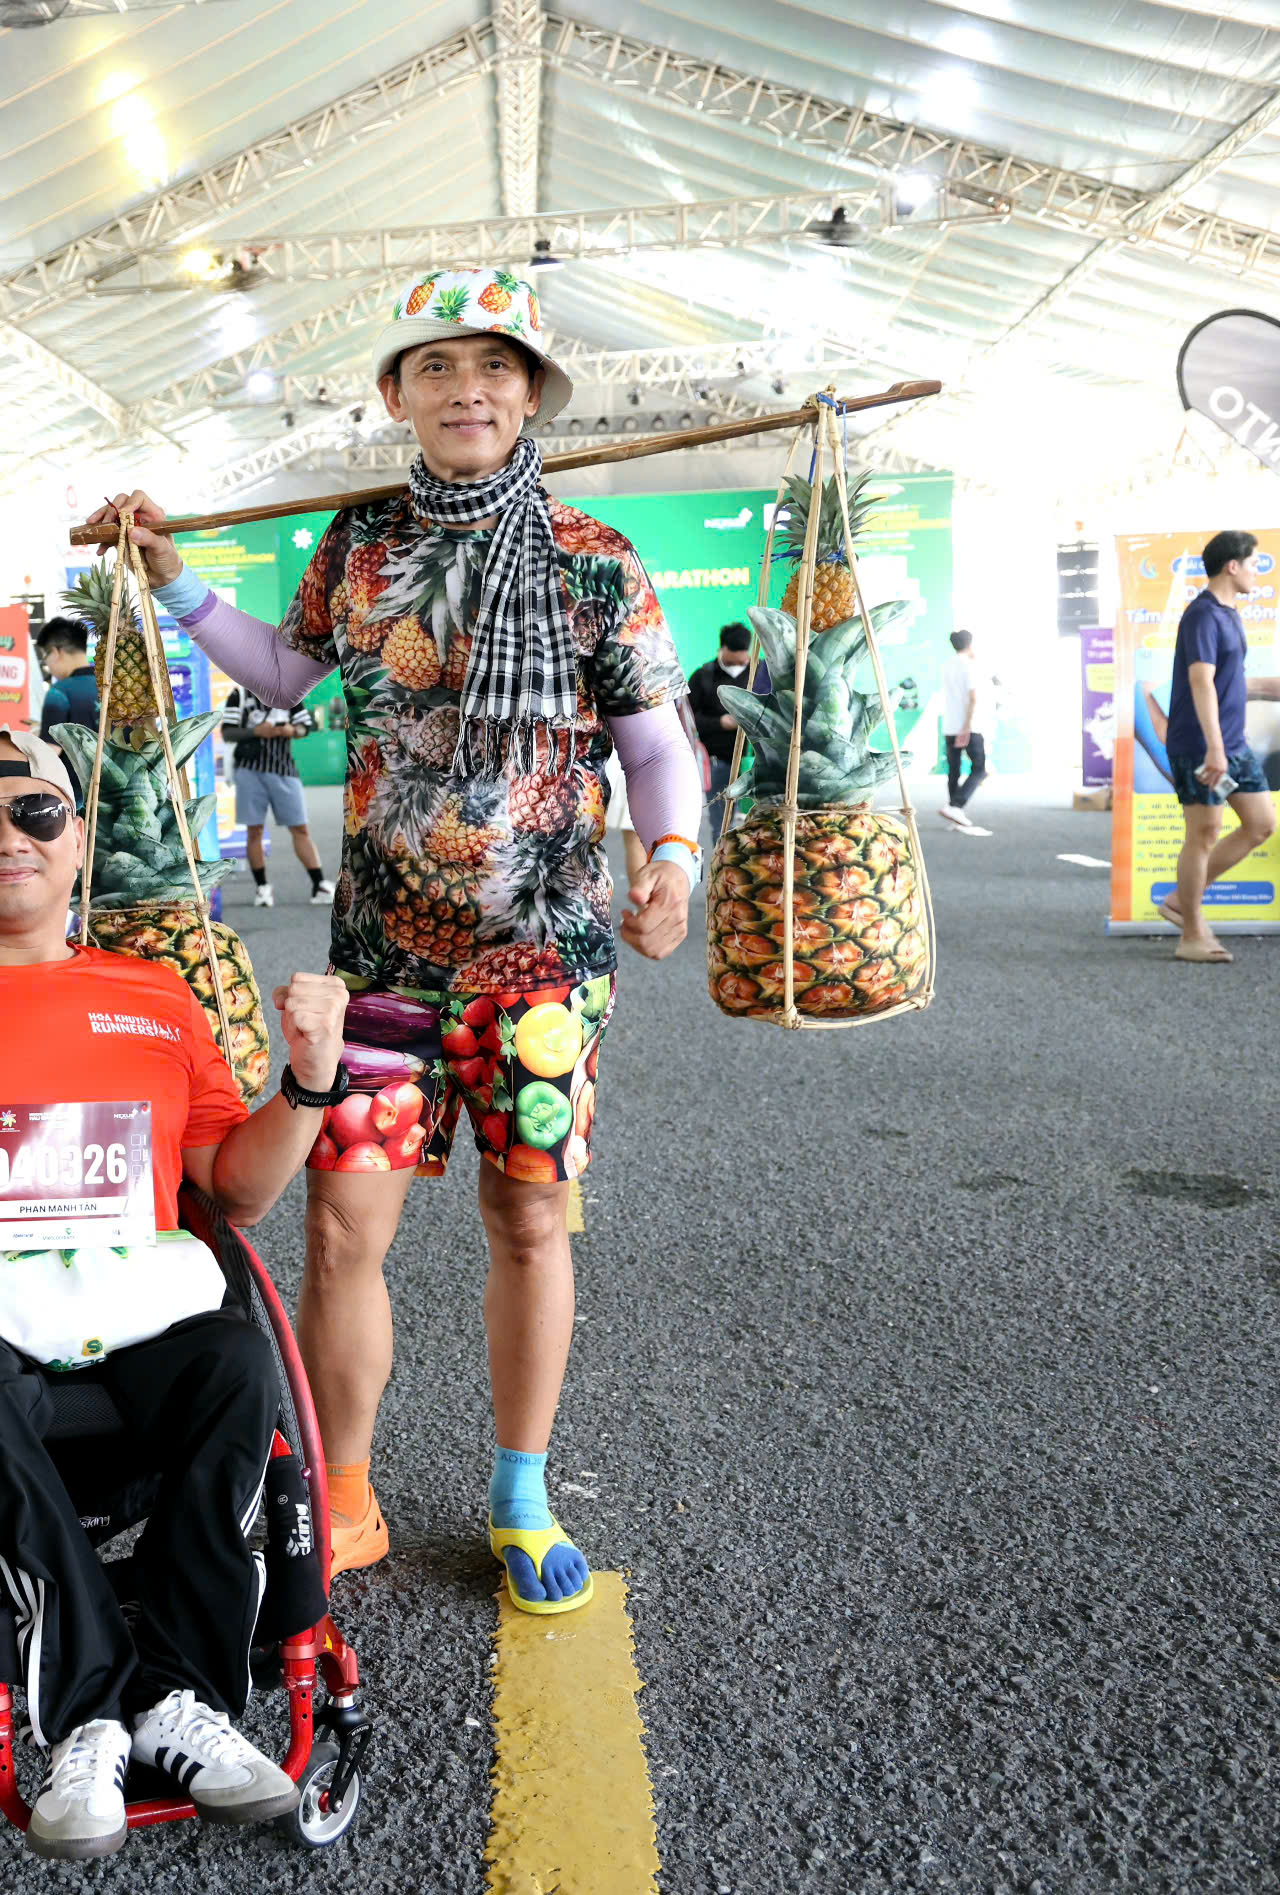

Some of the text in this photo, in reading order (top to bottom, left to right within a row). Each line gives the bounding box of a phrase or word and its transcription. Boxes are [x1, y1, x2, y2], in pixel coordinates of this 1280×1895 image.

[647, 567, 750, 590] ARATHON
[91, 1021, 155, 1037] RUNNERS
[20, 1206, 46, 1214] PHAN
[48, 1204, 77, 1215] MẠNH
